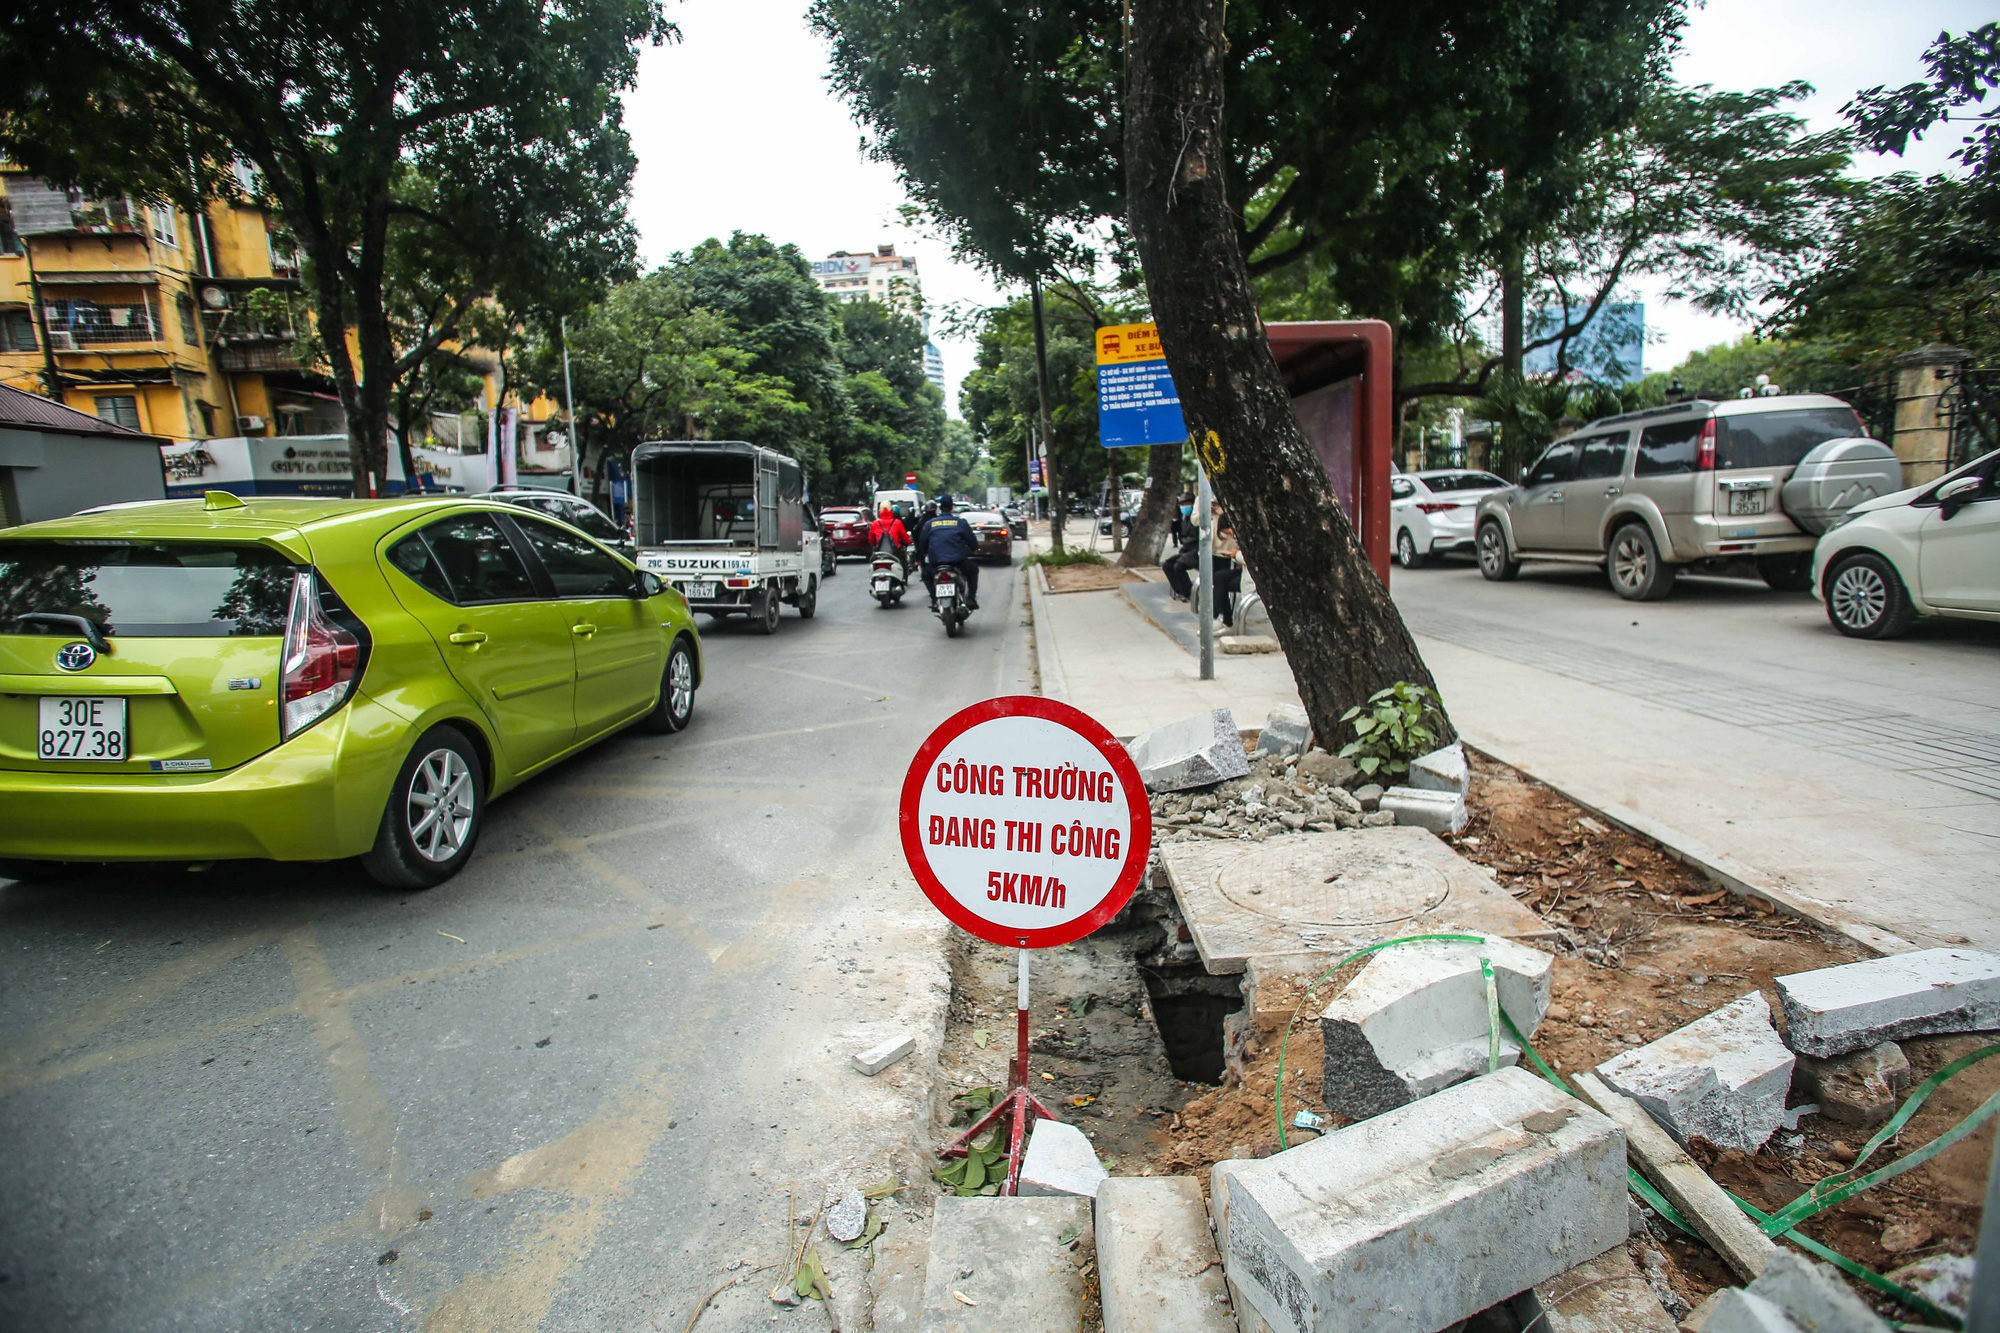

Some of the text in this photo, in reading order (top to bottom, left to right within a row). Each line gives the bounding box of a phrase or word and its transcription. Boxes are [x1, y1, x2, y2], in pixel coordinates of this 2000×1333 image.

[813, 260, 845, 273] BIDV
[1135, 342, 1161, 352] XE BU
[1736, 501, 1760, 513] 3531
[647, 559, 750, 569] 29C SUZUKI 169.47
[688, 588, 712, 597] 169.47
[58, 700, 104, 727] 30E
[41, 730, 122, 757] 827.38
[936, 757, 1114, 803] CÔNG TRƯỜNG
[929, 815, 1121, 860] ĐANG THI CÔNG
[987, 871, 1067, 909] 5KM/h
